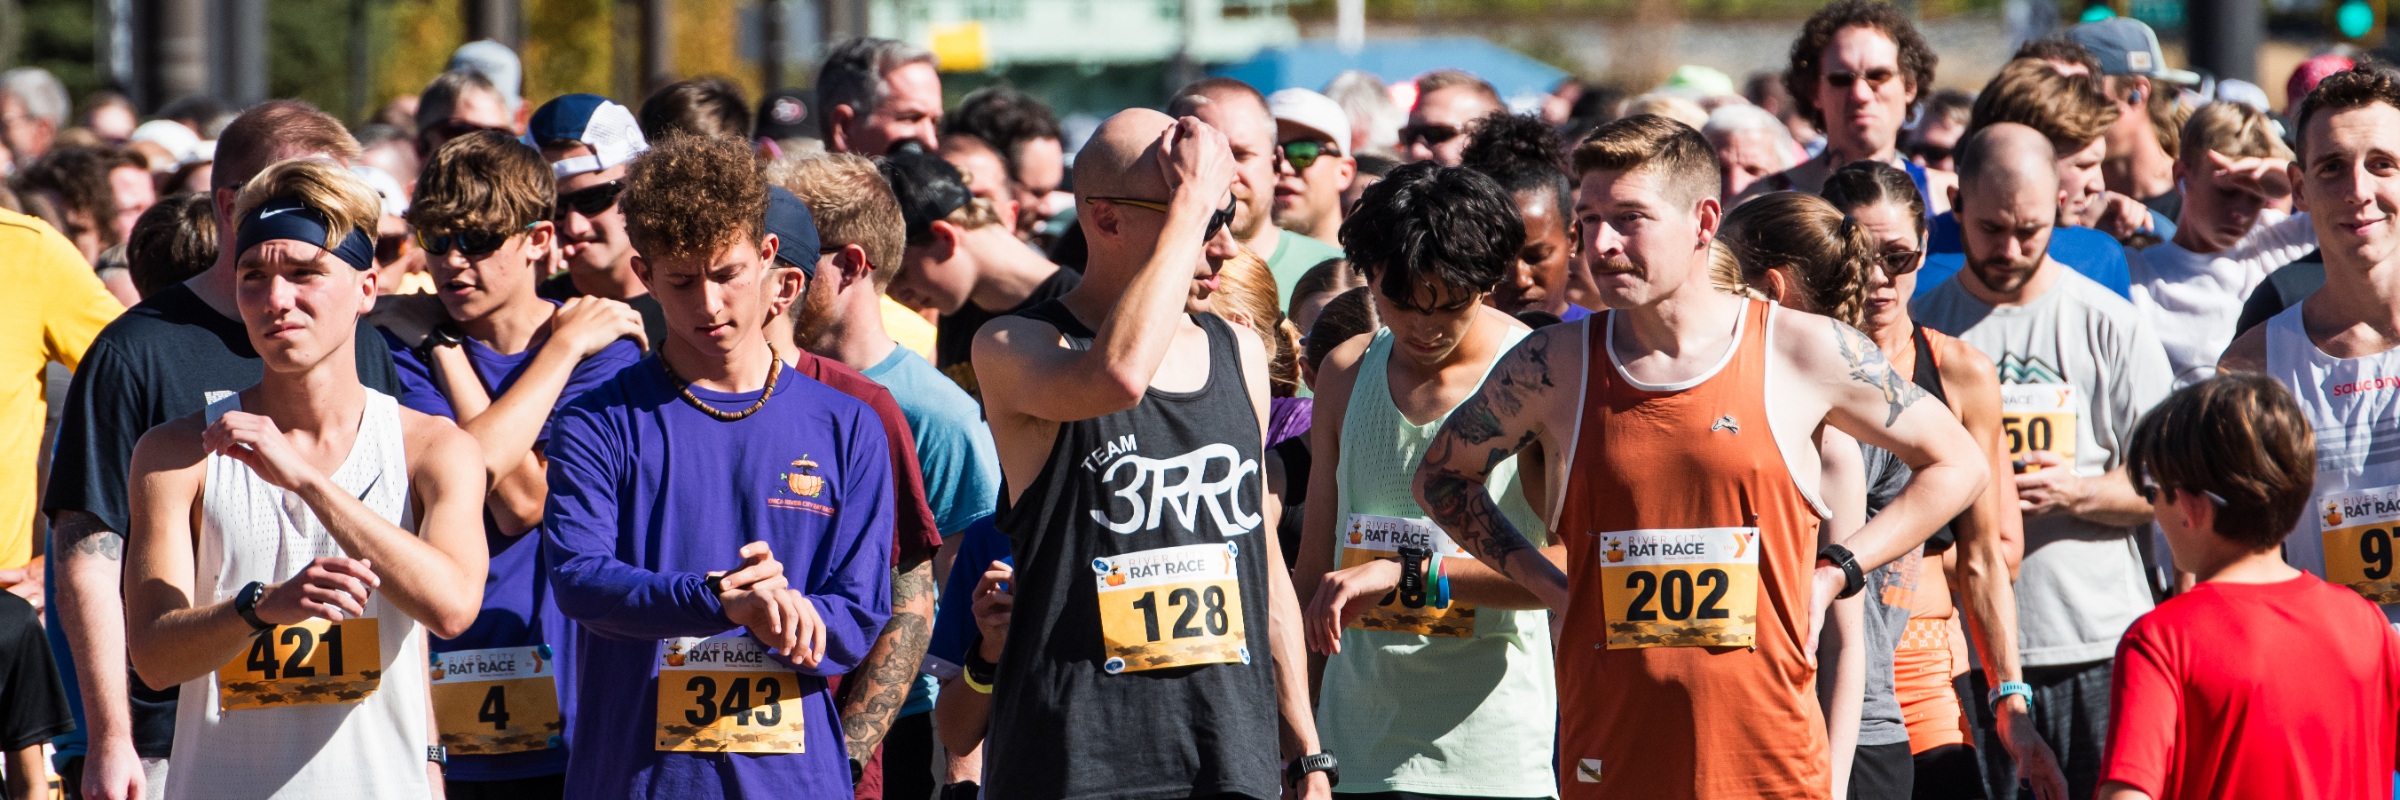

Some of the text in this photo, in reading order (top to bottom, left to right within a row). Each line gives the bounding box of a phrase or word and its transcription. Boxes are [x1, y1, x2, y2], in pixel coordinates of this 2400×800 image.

[1081, 434, 1138, 473] TEAM
[1089, 443, 1262, 536] 3RRC
[2343, 494, 2379, 506] RIVER
[2345, 503, 2371, 518] RAT
[1366, 521, 1431, 534] RIVER CITY
[1365, 529, 1430, 546] RAT RACE
[1628, 534, 1706, 545] RIVER CITY
[1628, 543, 1705, 557] RAT RACE
[1128, 554, 1171, 567] RIVER
[1130, 559, 1206, 579] RAT RACE
[1626, 568, 1730, 622] 202
[1132, 585, 1229, 642] 128
[246, 624, 343, 680] 421
[690, 642, 758, 651] RIVER CIT
[448, 652, 516, 664] RIVER CITY
[690, 650, 763, 663] RAT RACE
[448, 660, 516, 675] RAT RACE
[478, 685, 510, 730] 4
[684, 675, 782, 727] 343
